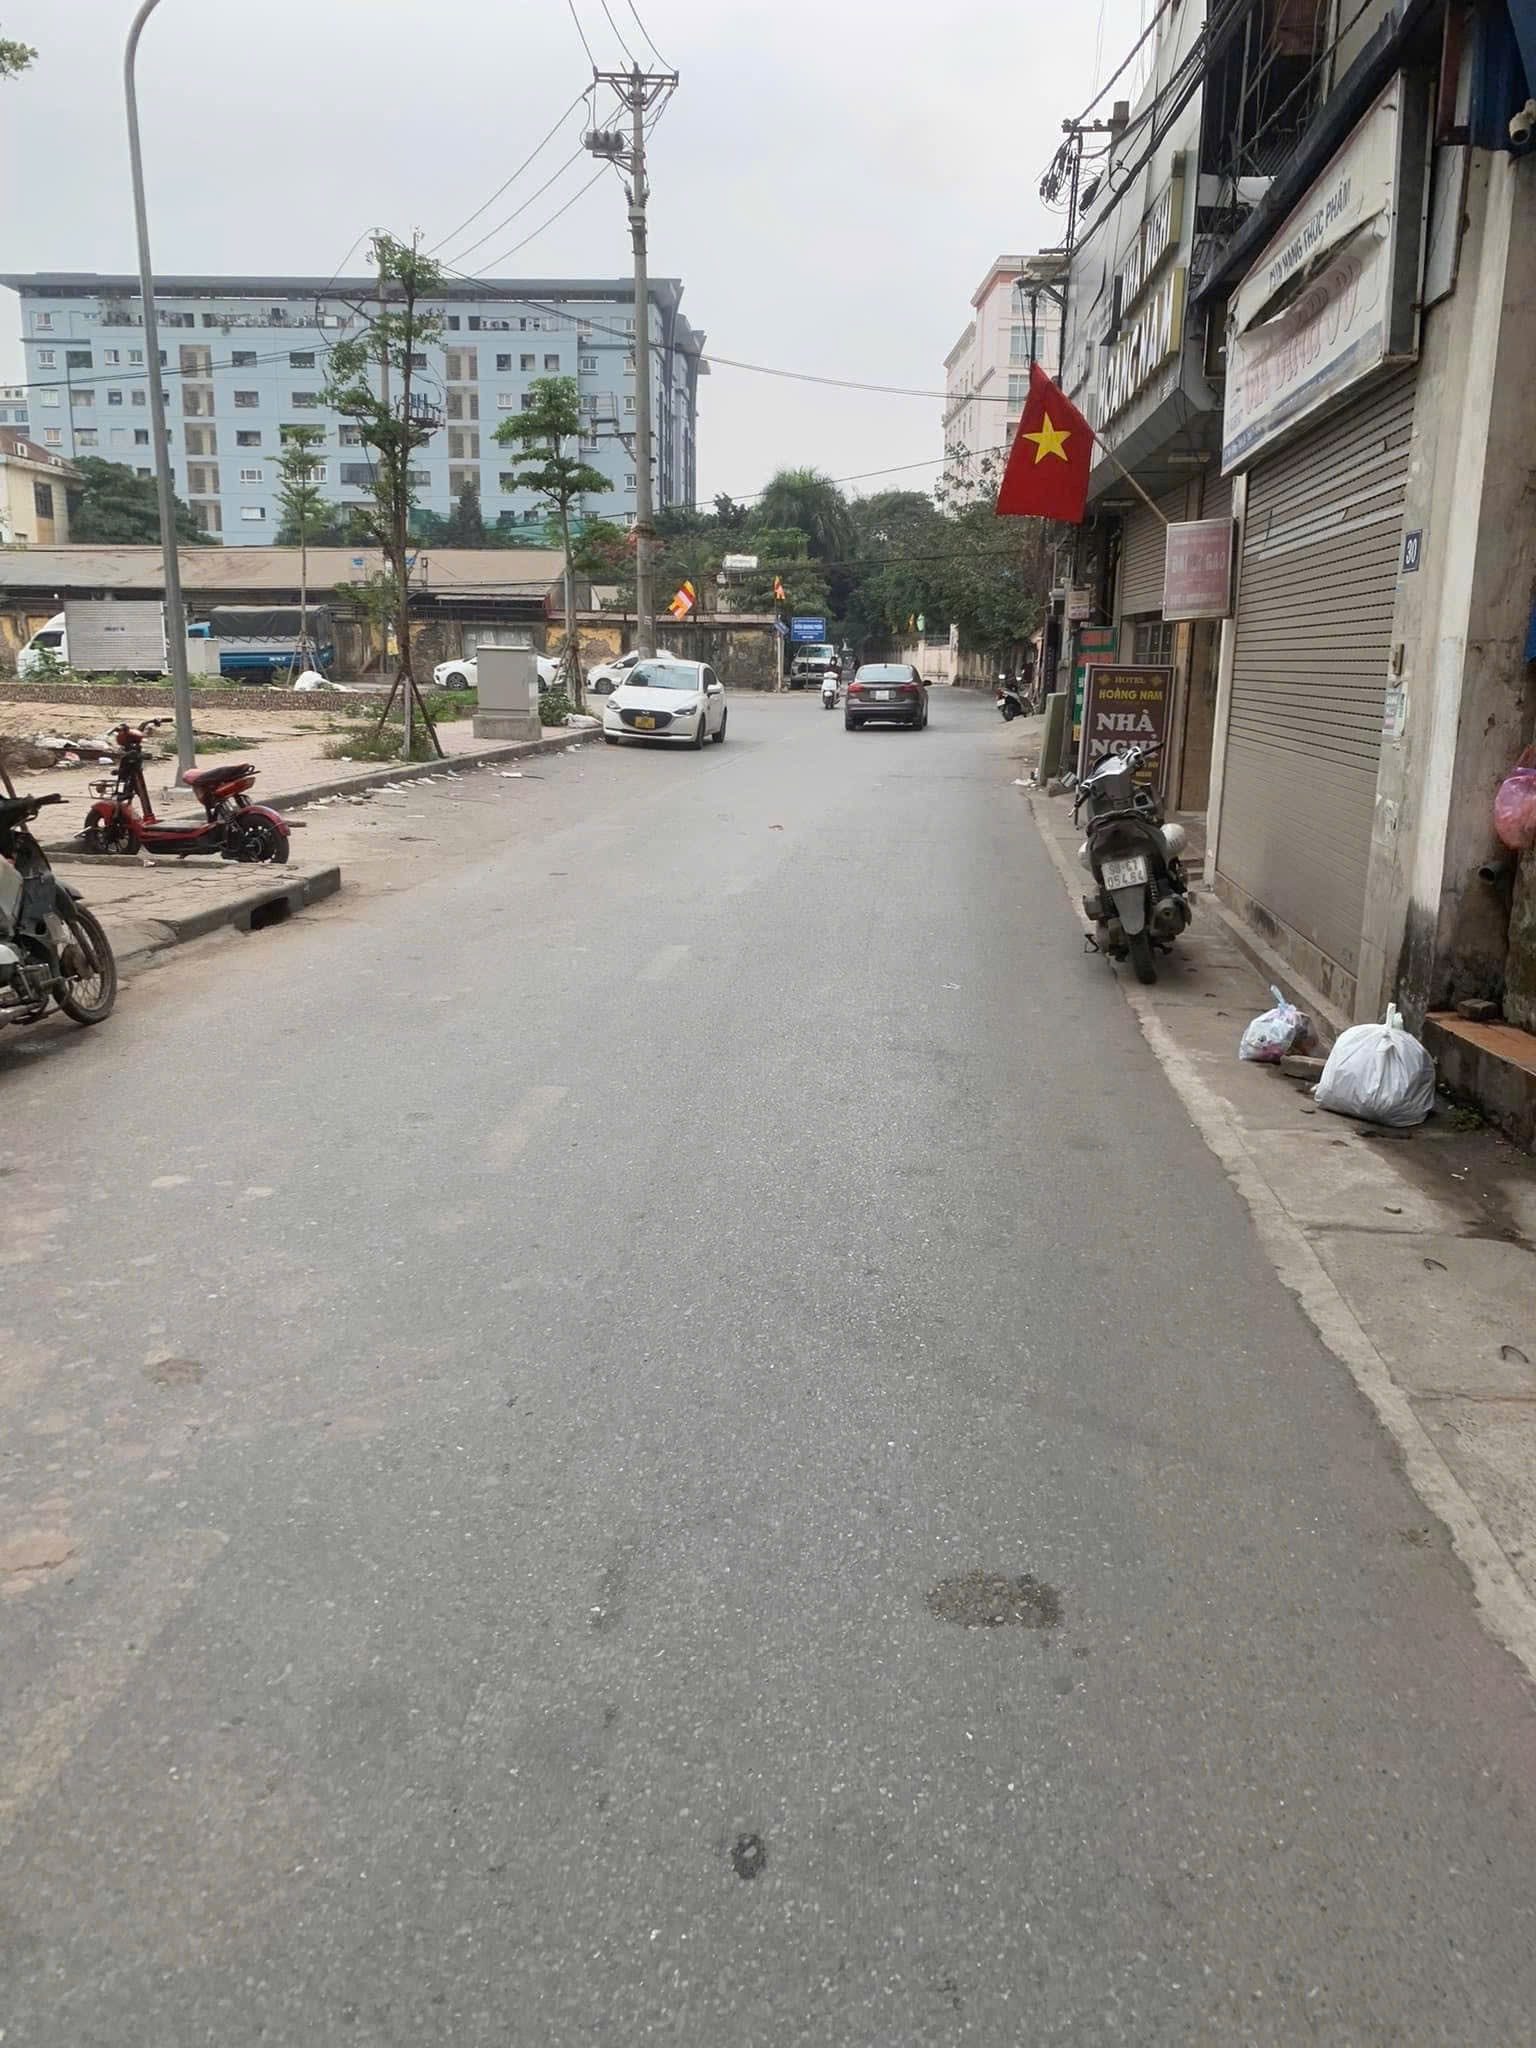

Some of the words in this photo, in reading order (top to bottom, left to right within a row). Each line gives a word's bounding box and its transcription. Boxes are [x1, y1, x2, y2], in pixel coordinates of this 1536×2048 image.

[1138, 270, 1176, 390] NAM
[1405, 537, 1417, 566] 30
[1114, 676, 1146, 684] HOTEL
[1099, 688, 1137, 700] HOÀNG
[1139, 690, 1163, 700] NAM
[1096, 709, 1155, 732] NHÀ
